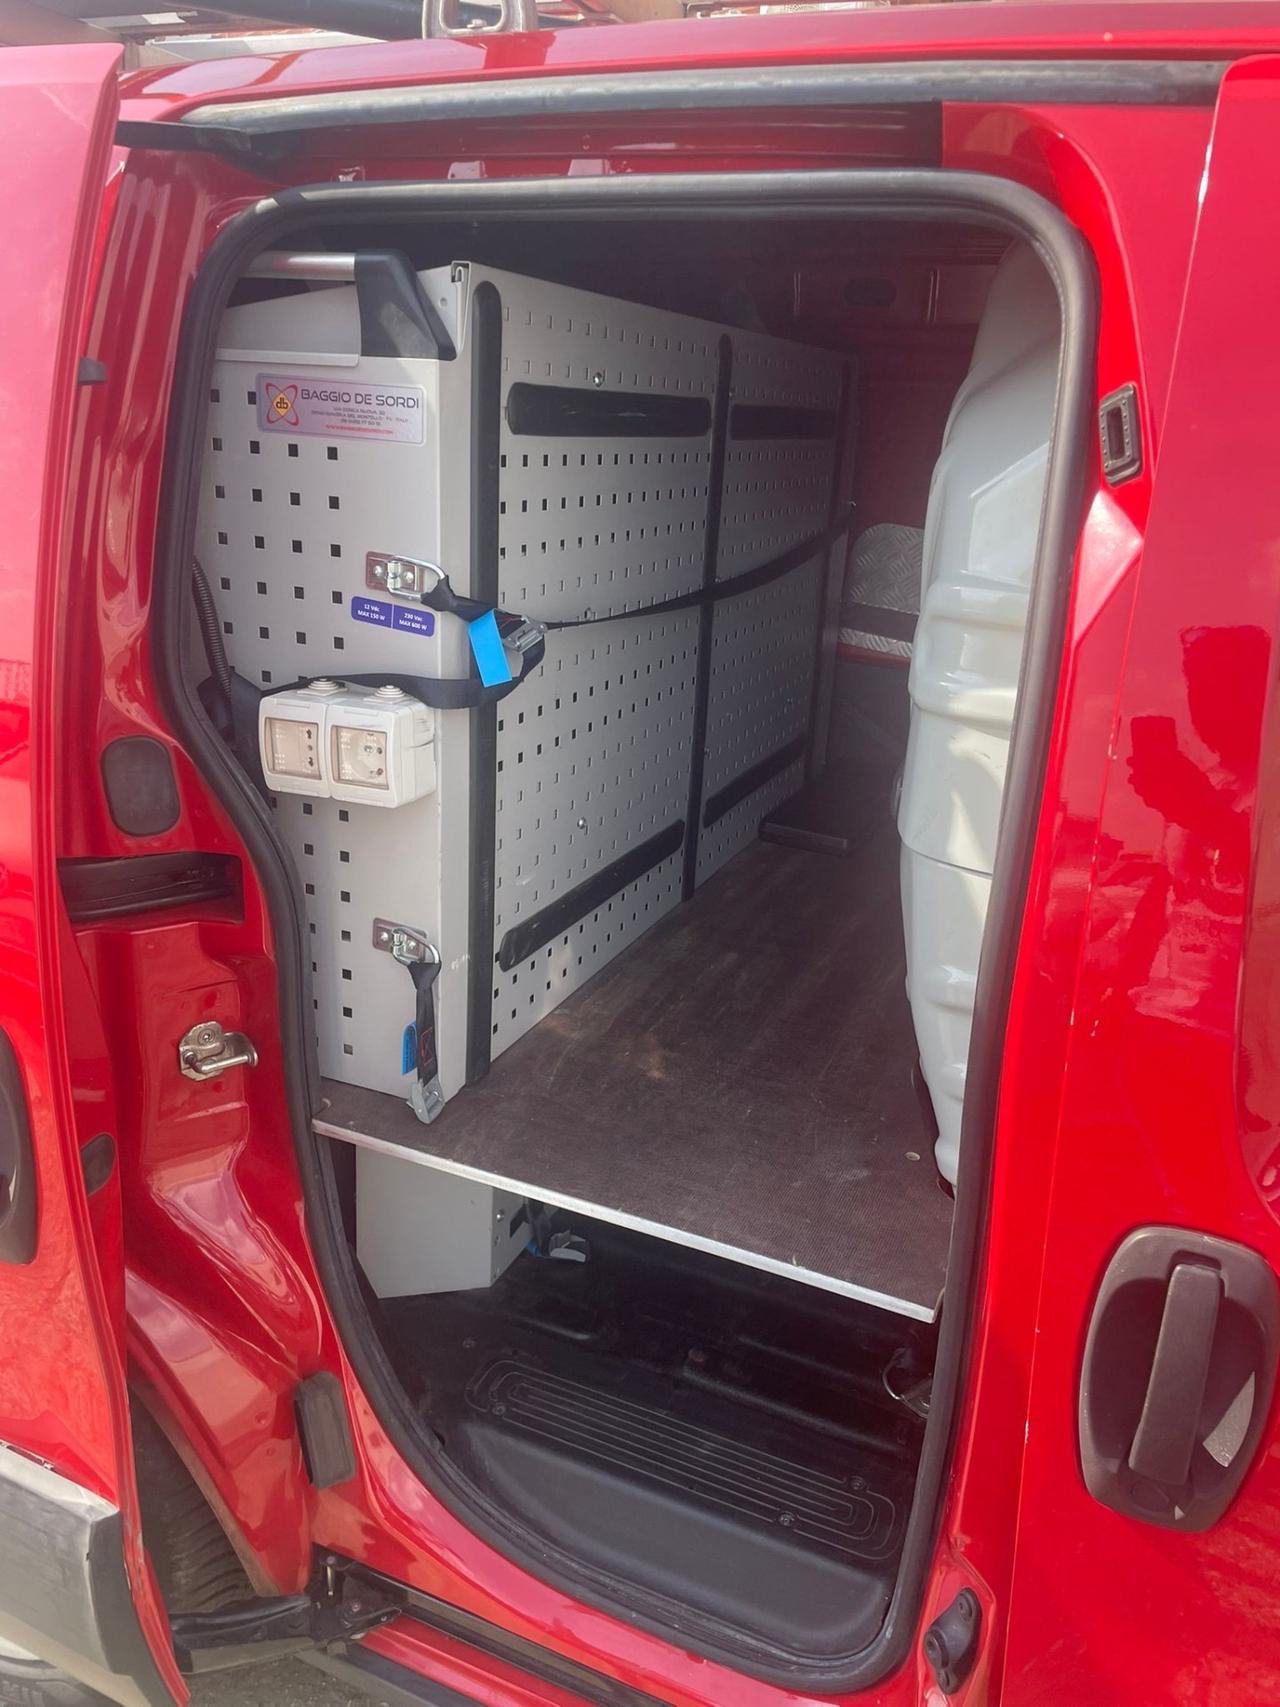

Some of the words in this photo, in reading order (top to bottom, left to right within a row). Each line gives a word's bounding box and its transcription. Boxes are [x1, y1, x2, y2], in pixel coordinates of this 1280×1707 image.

[301, 388, 351, 403] BAGGIO
[354, 393, 372, 405] DE
[375, 395, 419, 408] SORDI
[399, 619, 411, 627] MAX
